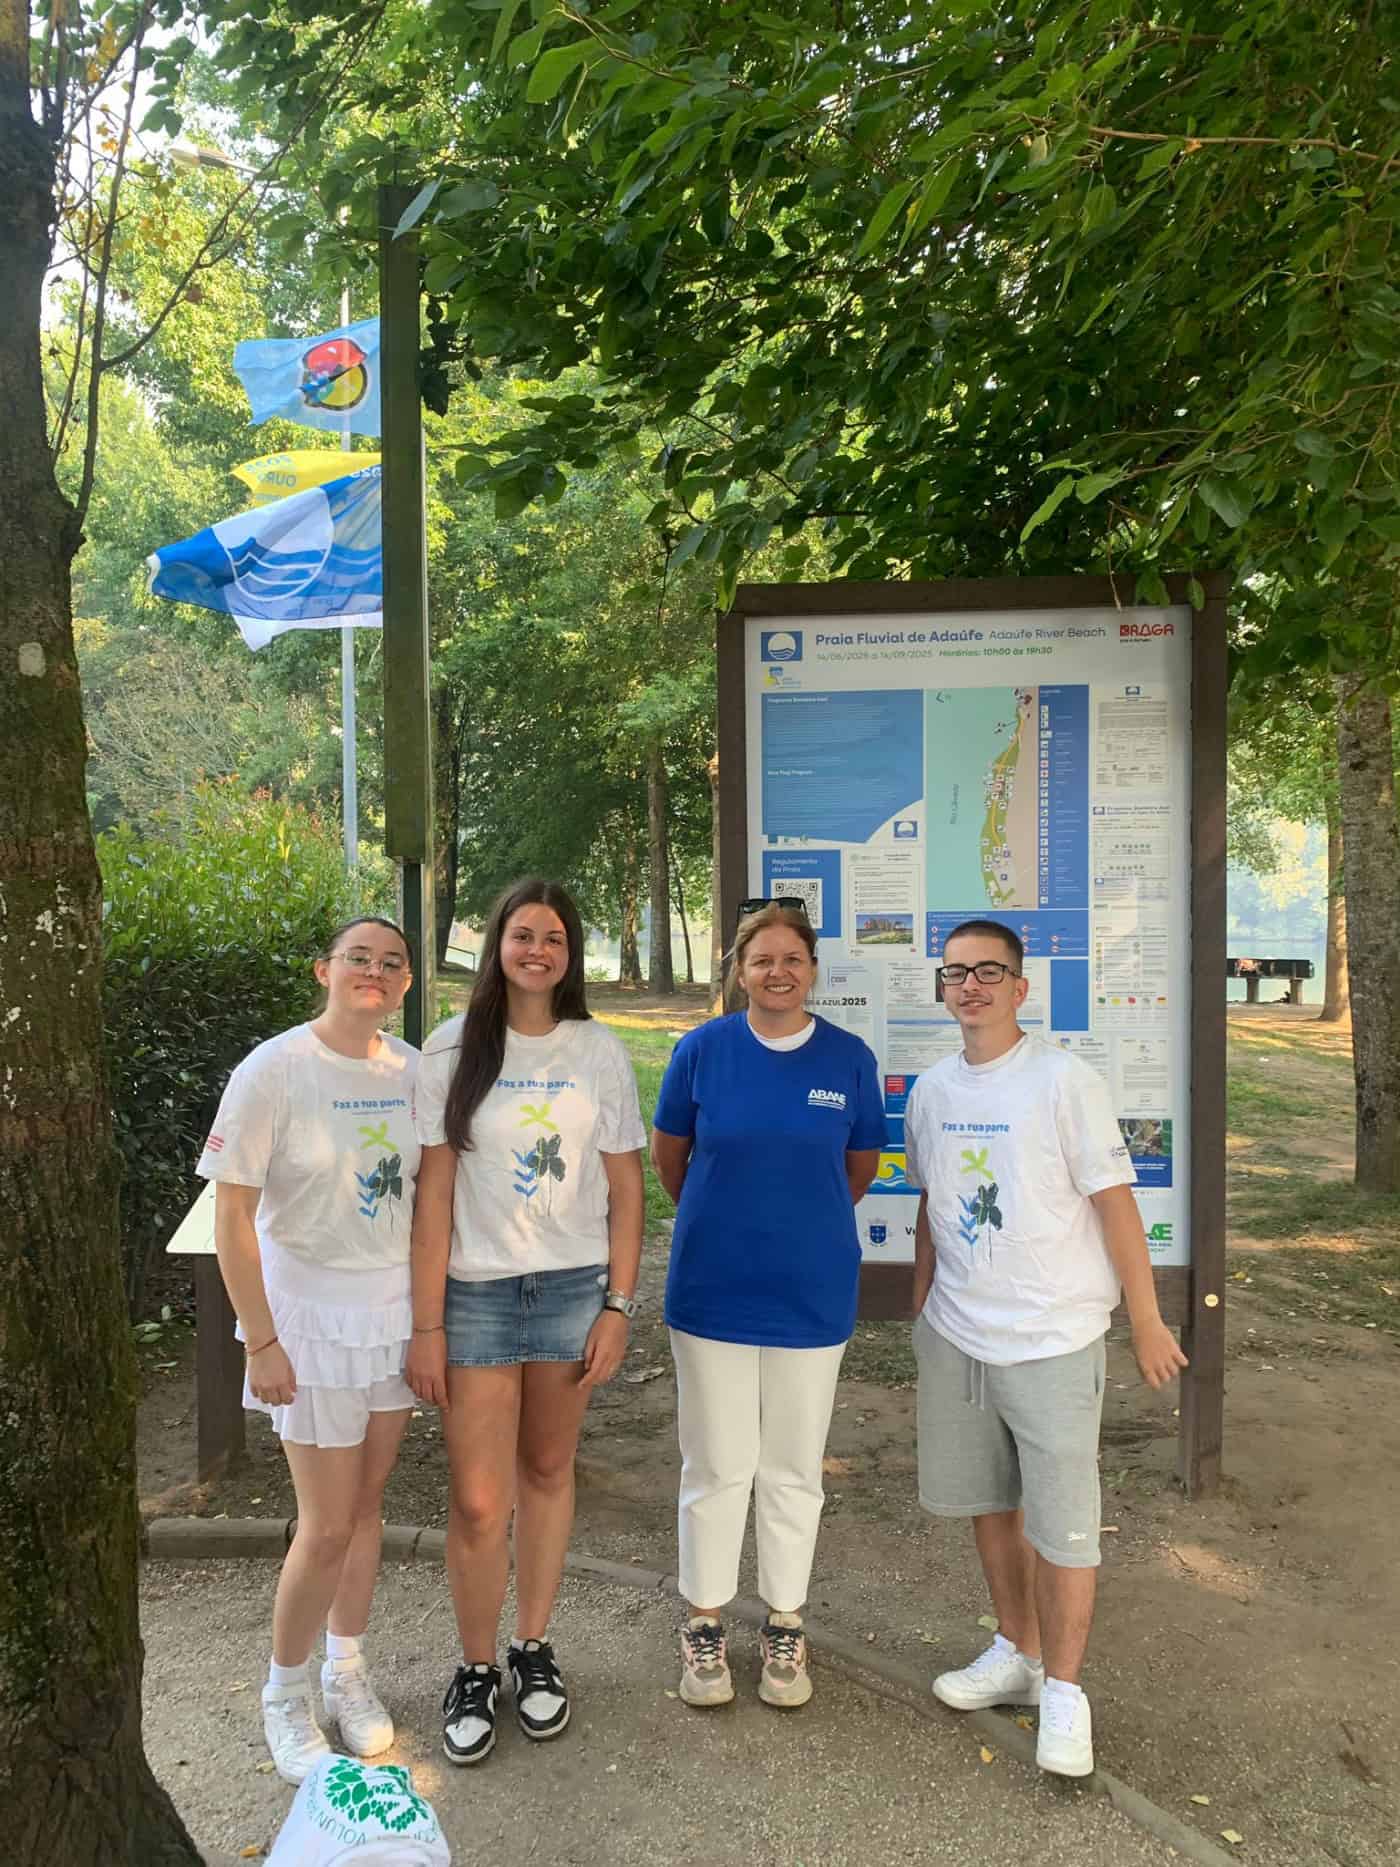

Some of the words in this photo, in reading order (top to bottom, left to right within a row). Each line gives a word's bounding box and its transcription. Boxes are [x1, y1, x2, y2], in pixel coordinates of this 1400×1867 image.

[1119, 623, 1175, 637] BRAGA
[815, 633, 854, 646] Praia
[856, 631, 904, 645] Fluvial
[907, 631, 926, 643] de
[929, 629, 984, 643] Adaúfe
[1035, 627, 1065, 639] River
[1067, 626, 1106, 638] Beach
[353, 1100, 360, 1108] a
[361, 1099, 378, 1108] tua
[959, 1123, 965, 1132] a
